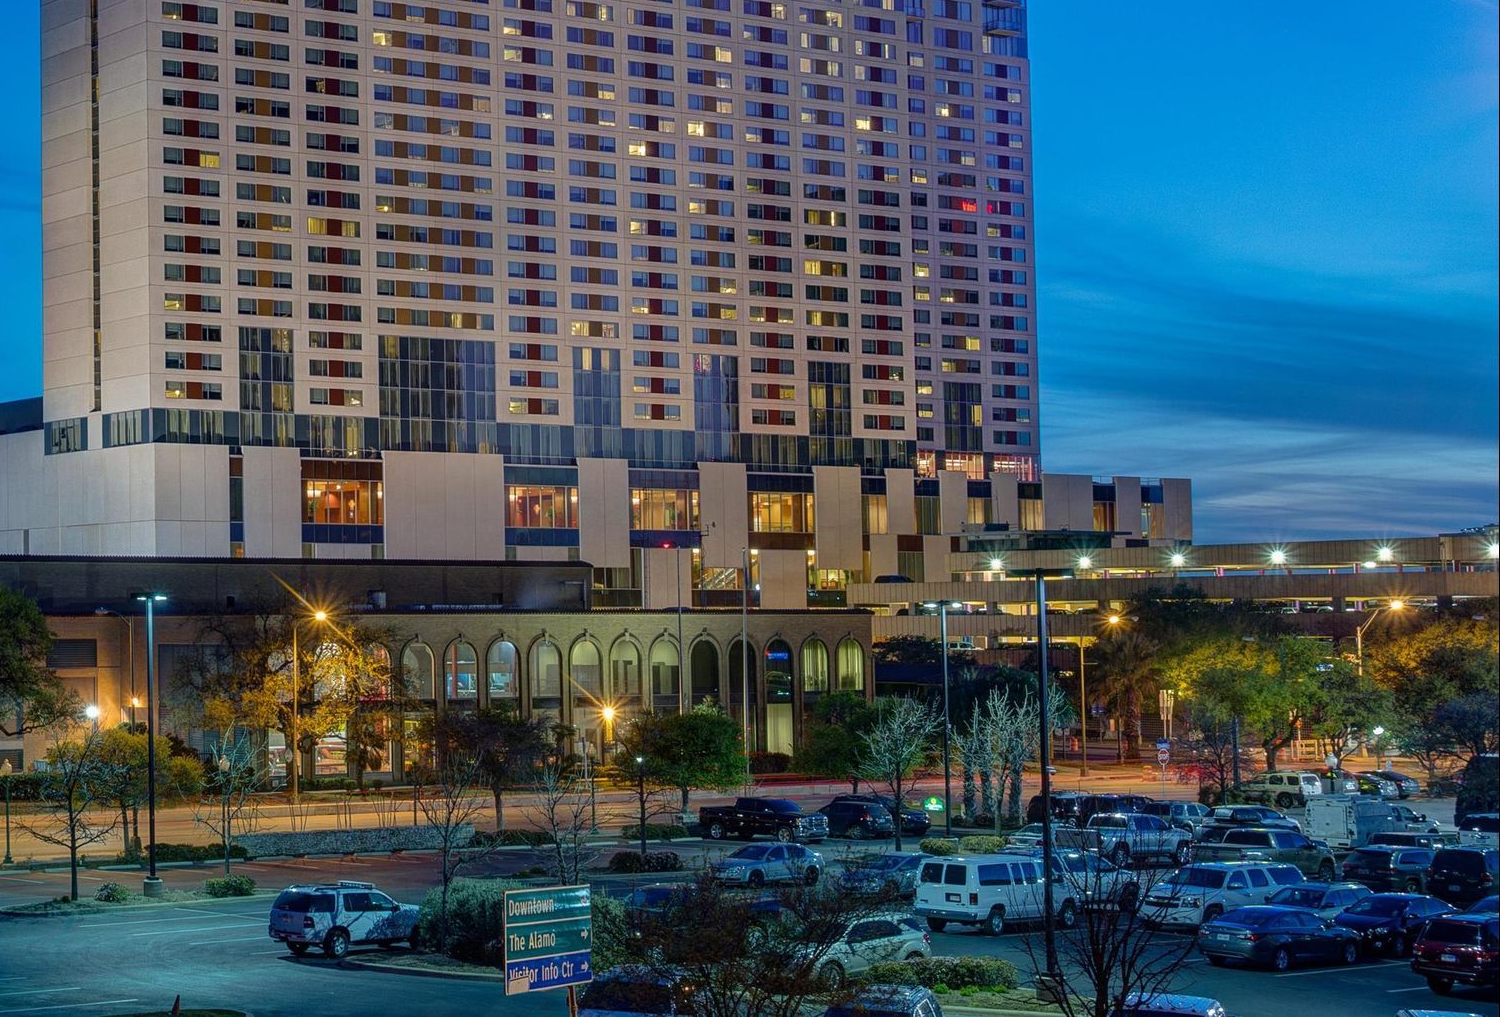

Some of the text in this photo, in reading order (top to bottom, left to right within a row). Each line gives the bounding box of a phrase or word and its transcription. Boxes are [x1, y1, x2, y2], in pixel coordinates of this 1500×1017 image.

[508, 898, 554, 917] Downtown
[509, 931, 556, 952] The Alamo
[541, 962, 558, 981] Info
[562, 961, 574, 978] Ctr
